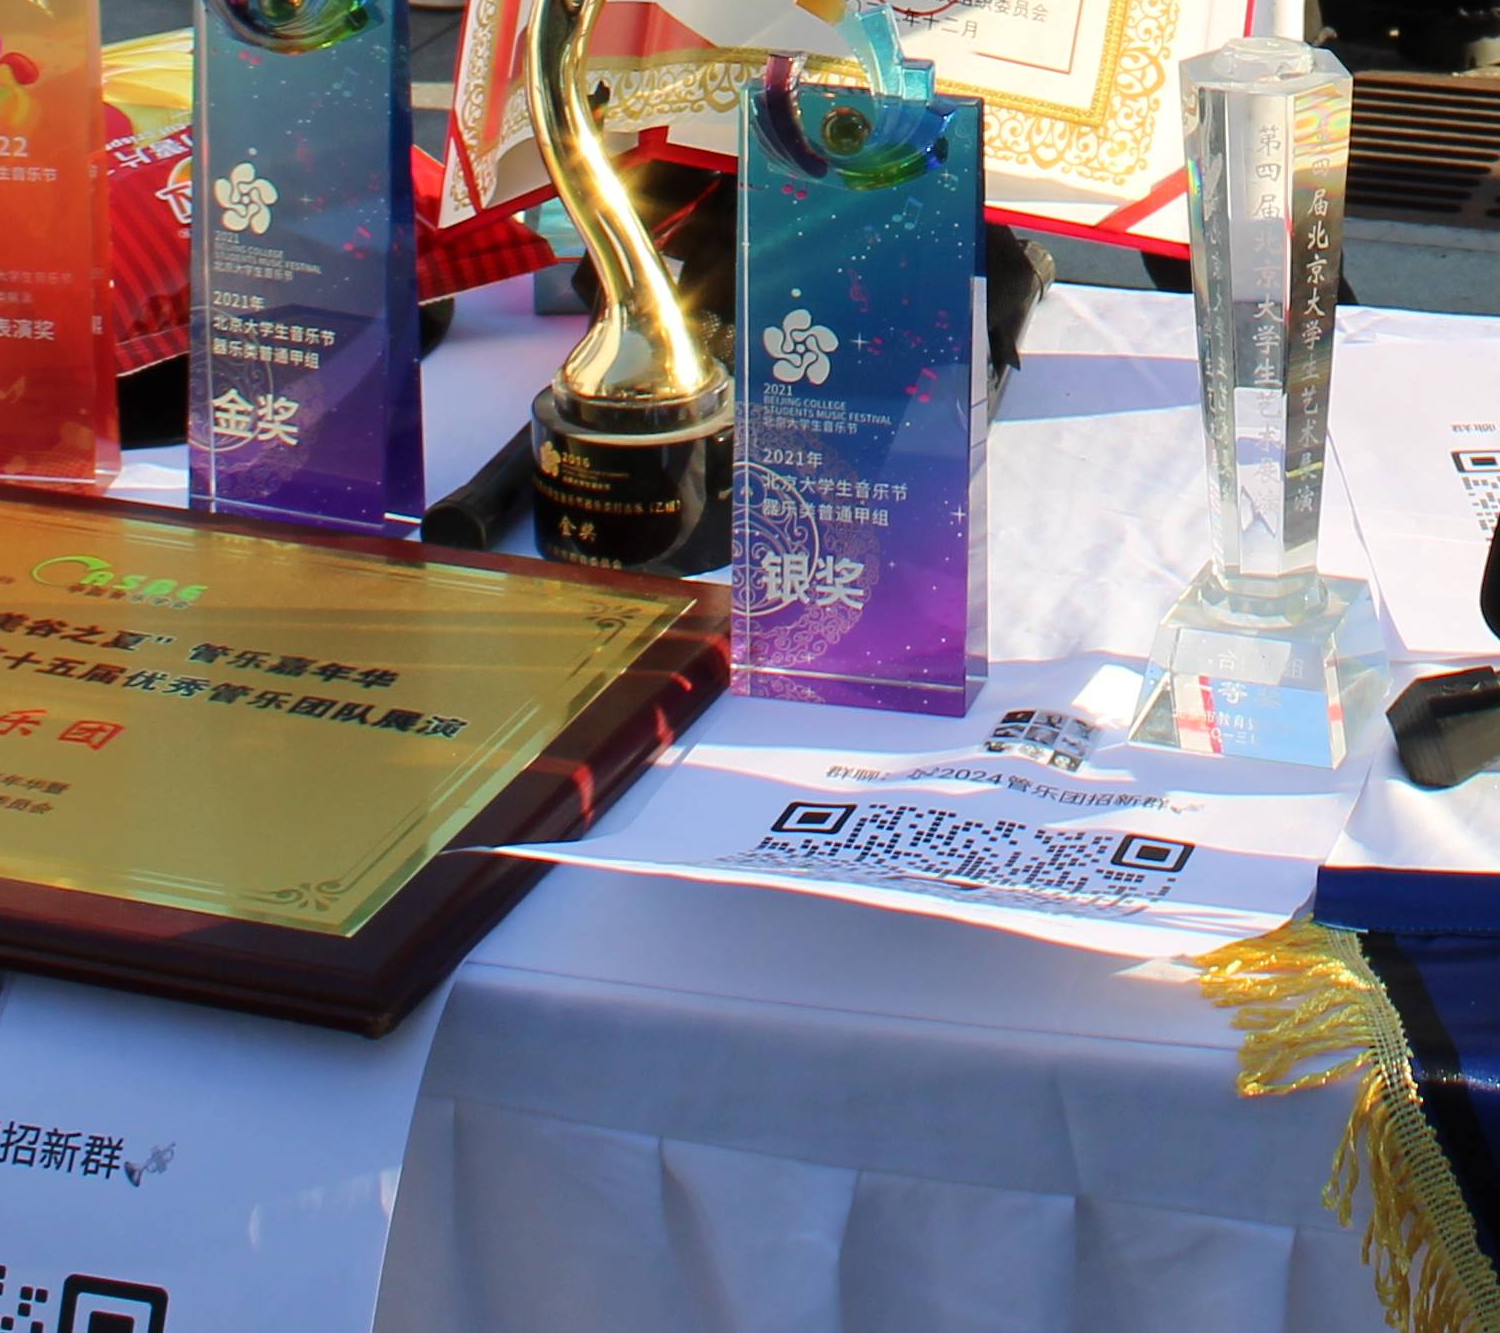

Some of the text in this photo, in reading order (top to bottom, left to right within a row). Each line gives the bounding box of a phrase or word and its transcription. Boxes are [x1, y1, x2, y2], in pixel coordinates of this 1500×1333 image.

[214, 230, 240, 244] 2021
[213, 290, 265, 311] 2021年
[213, 314, 336, 348] 北京大学生音乐节
[213, 337, 320, 371] 器乐类普通甲组
[763, 383, 793, 396] 2021
[763, 395, 846, 411] BEIJING COLLEGE
[212, 391, 300, 446] 金奖
[762, 416, 858, 434] 北京大学生音乐节
[763, 405, 893, 426] STUDENTS MUSIC FESTIVAL
[562, 452, 590, 469] 2016
[762, 449, 823, 469] 2021年
[762, 474, 909, 503] 北京大学生音乐节
[762, 499, 891, 527] 器乐类普通甲组
[557, 515, 598, 542] 金奖
[761, 551, 866, 610] 银奖
[189, 640, 398, 692] 管乐嘉年华
[932, 766, 1171, 814] 2024管乐团招新群
